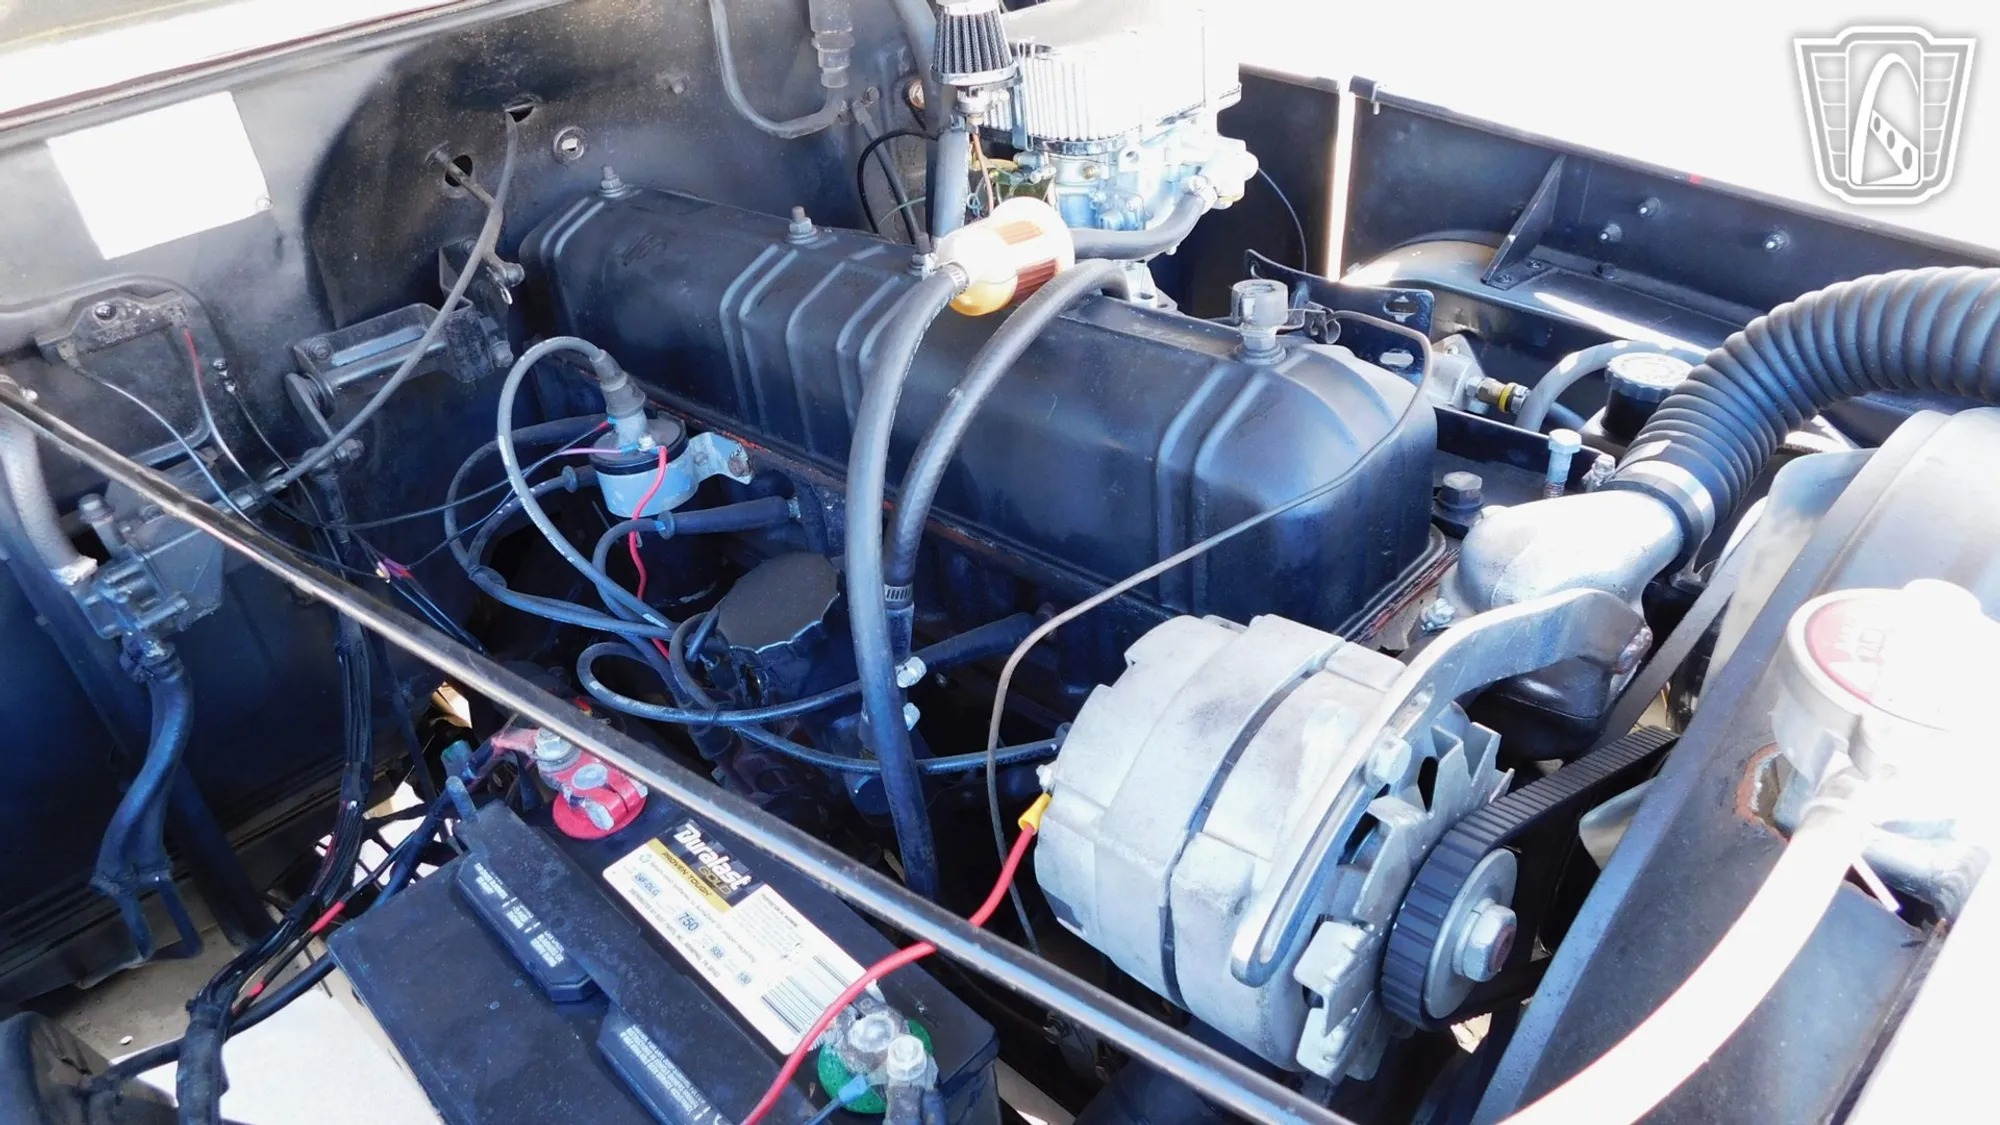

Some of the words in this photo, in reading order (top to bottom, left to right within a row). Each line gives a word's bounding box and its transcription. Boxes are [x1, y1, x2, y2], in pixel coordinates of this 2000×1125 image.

[661, 852, 688, 875] PROVEN
[687, 873, 712, 896] TOUGH
[674, 823, 752, 890] Duralast
[698, 866, 732, 895] GOLD
[678, 912, 699, 931] 750
